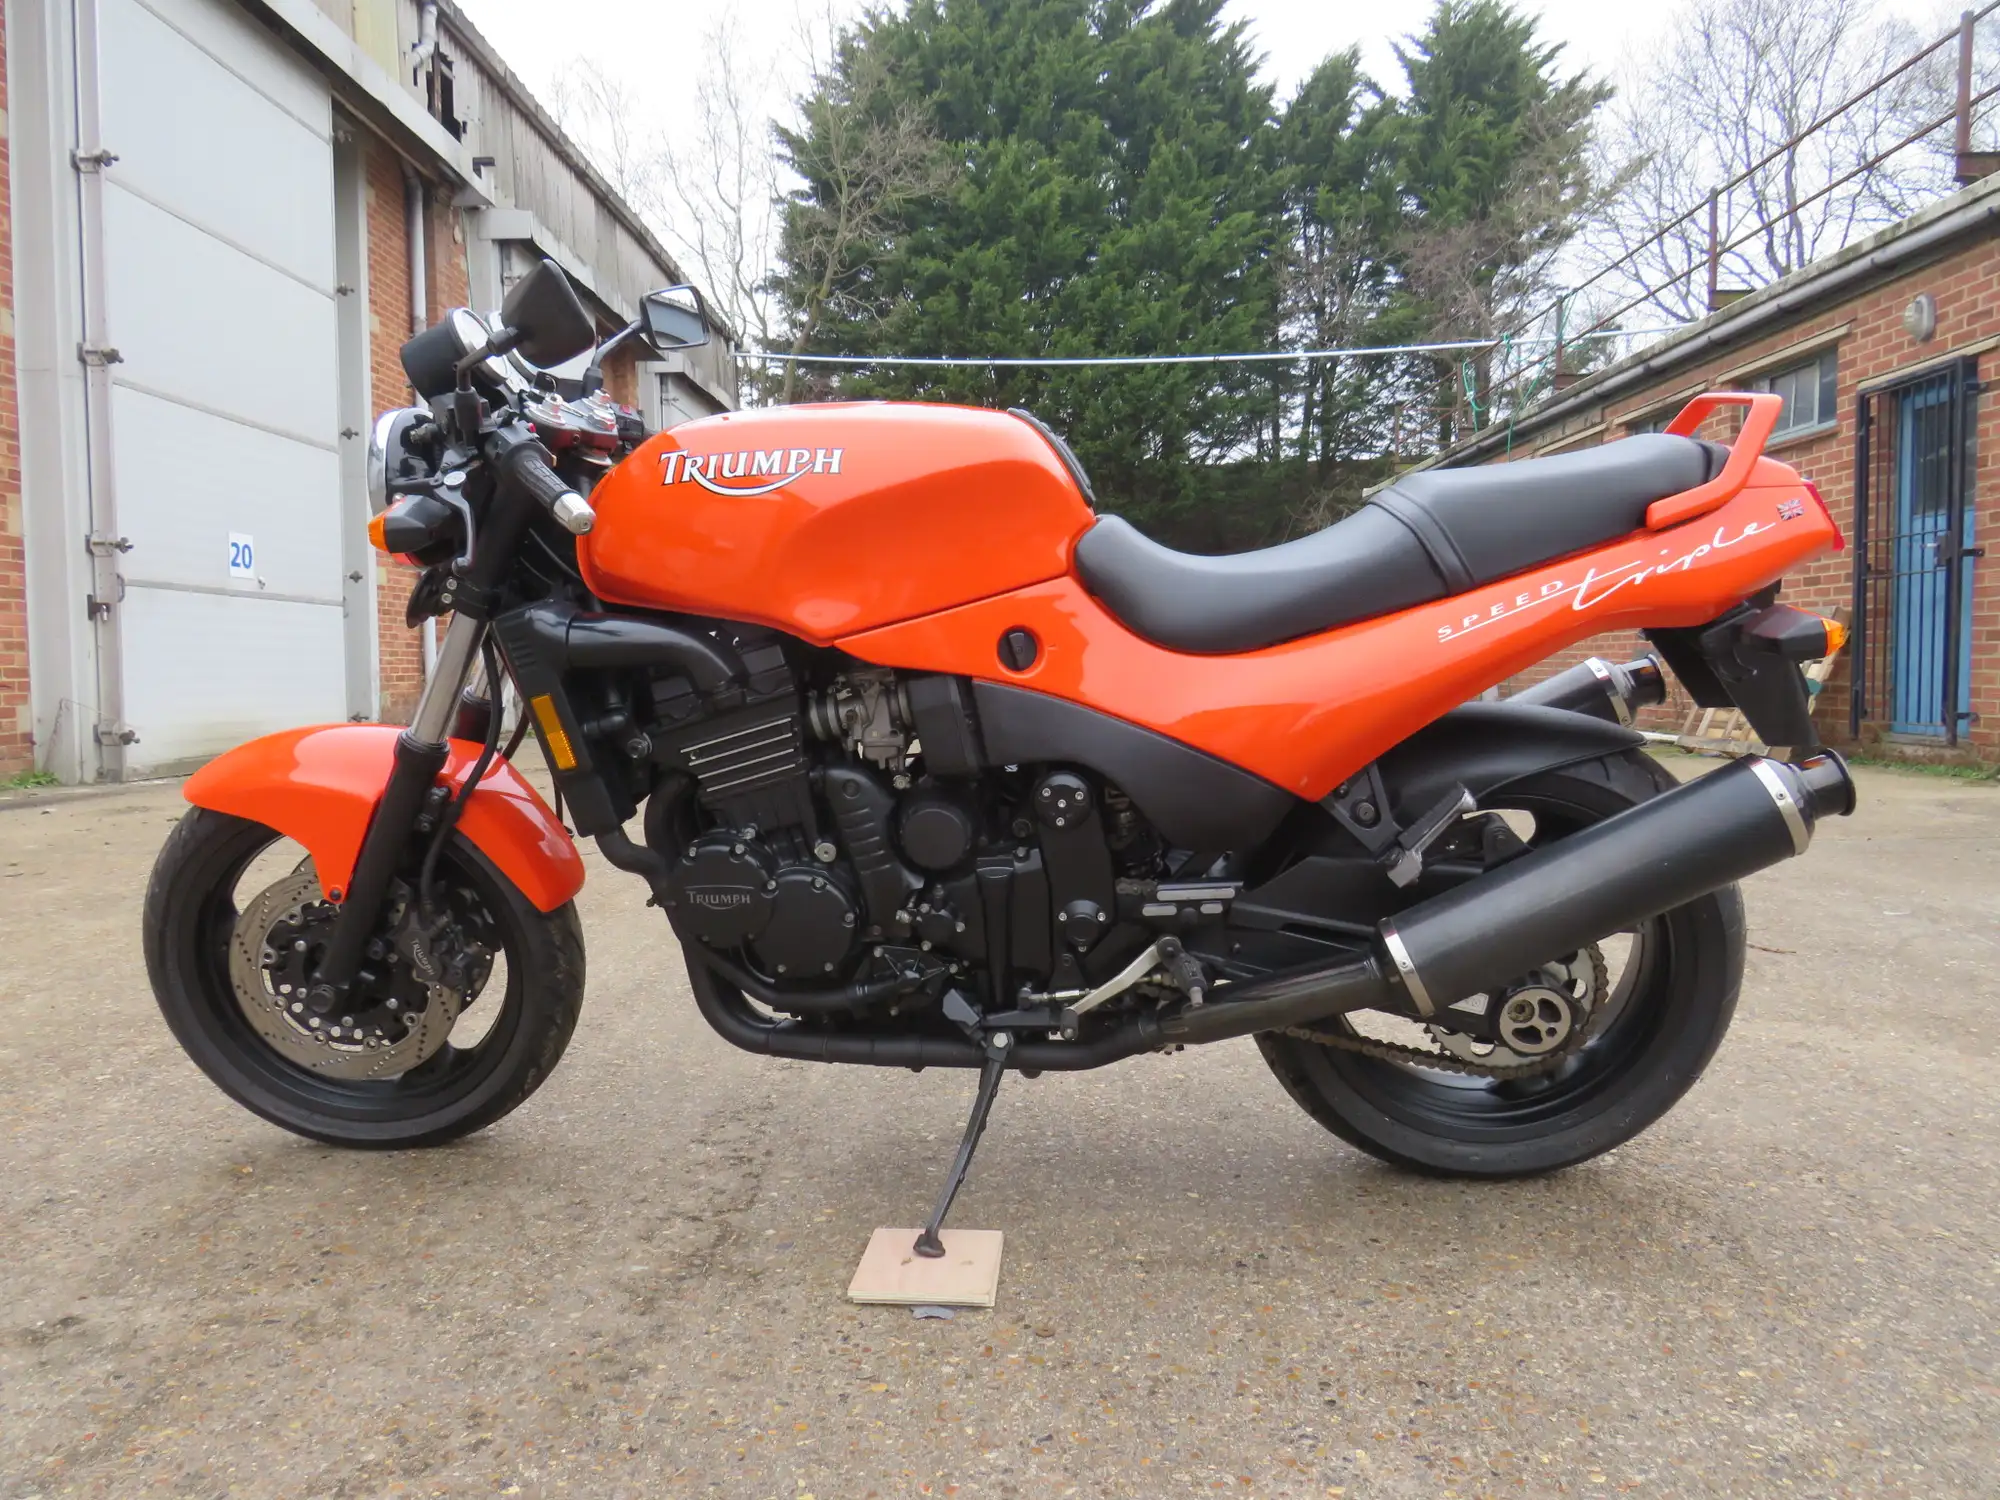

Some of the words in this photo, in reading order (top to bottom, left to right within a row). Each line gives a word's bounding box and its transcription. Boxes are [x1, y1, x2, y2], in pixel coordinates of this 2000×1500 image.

[658, 448, 845, 496] TRIUMPH
[230, 541, 253, 569] 20
[1437, 580, 1564, 639] SPEED
[1572, 521, 1776, 611] triple
[685, 890, 751, 910] TRIUMPH
[410, 938, 436, 976] TRIUMPH
